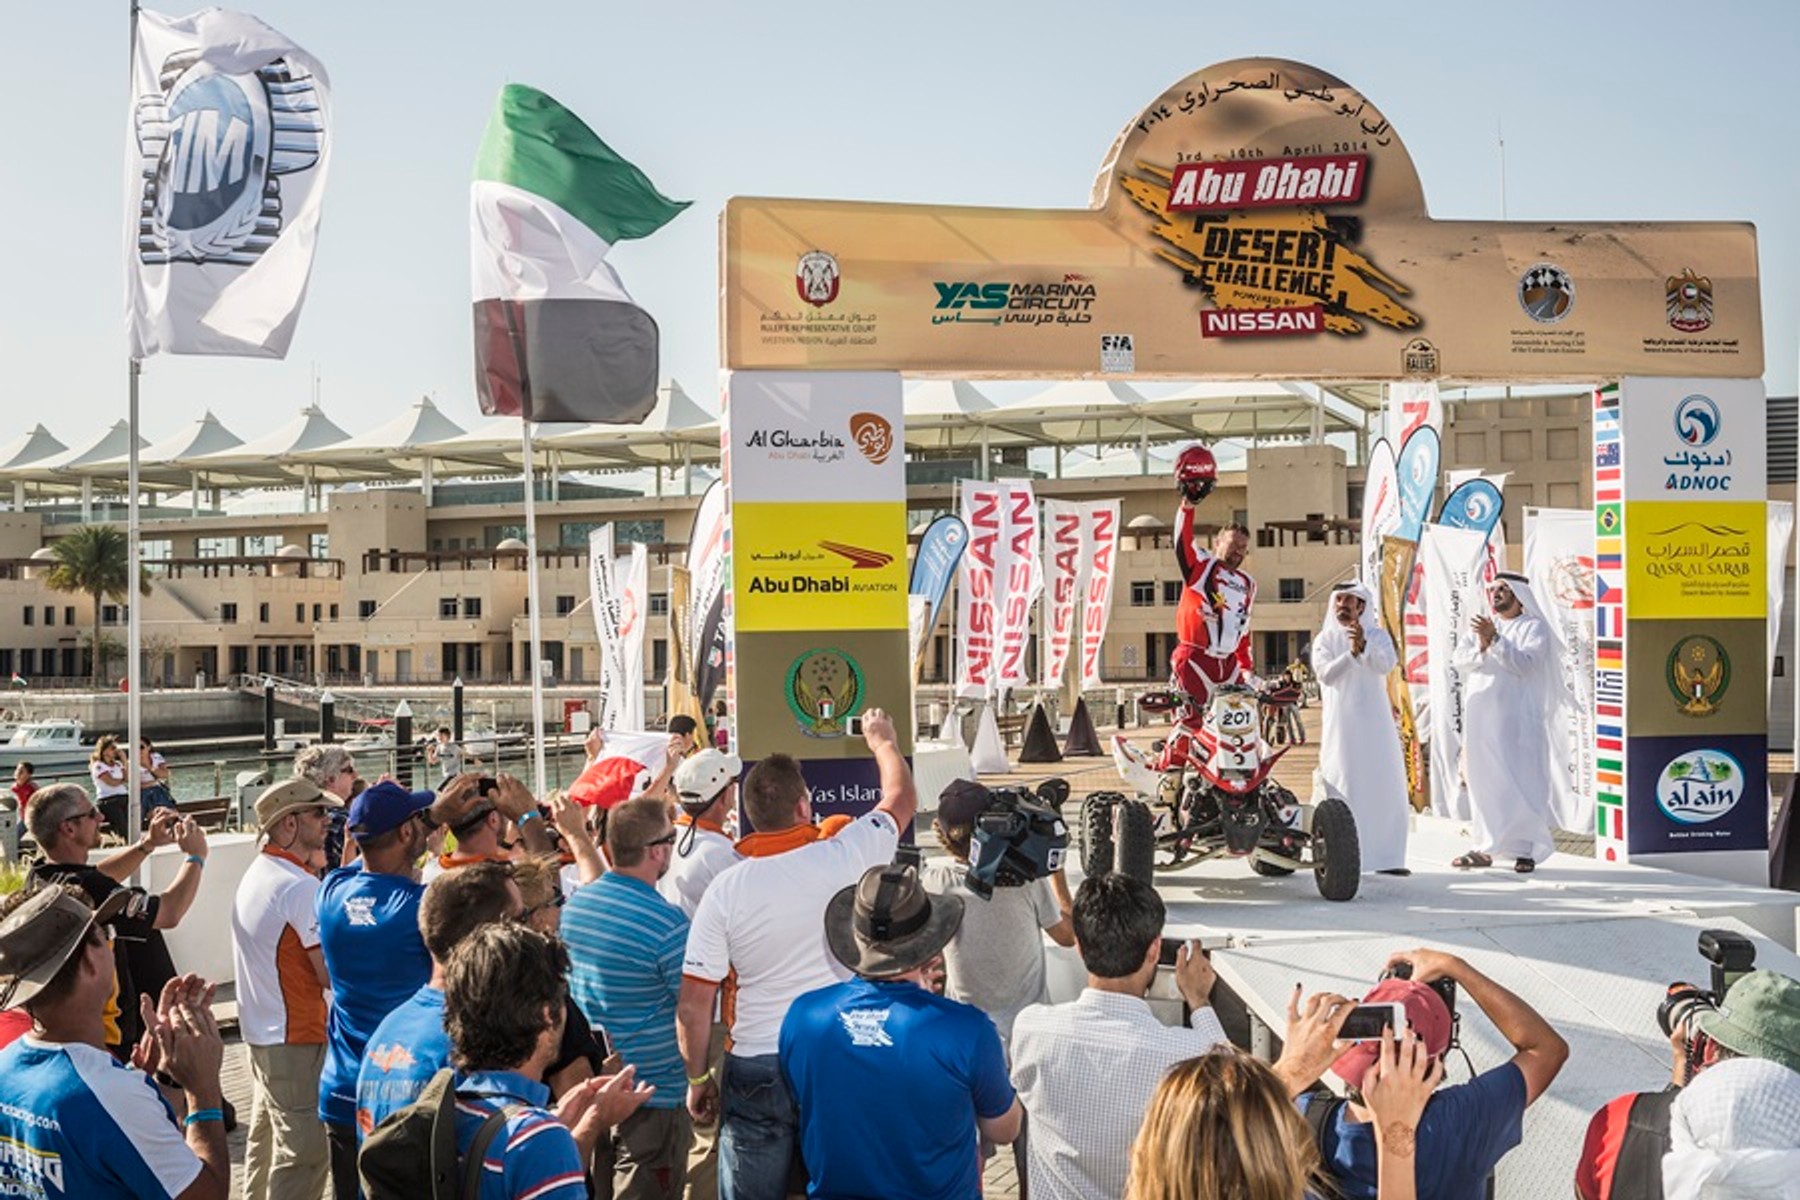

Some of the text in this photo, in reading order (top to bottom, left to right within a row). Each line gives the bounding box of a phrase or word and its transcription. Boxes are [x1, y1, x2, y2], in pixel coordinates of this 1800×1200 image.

[1178, 73, 1280, 115] الصحراوي
[1176, 152, 1203, 162] 3rd
[1229, 147, 1264, 159] 10th
[1283, 143, 1323, 156] April
[1333, 141, 1368, 153] 2014
[1170, 160, 1358, 206] Abu Dhabi
[1202, 227, 1338, 271] DESERT
[1010, 284, 1097, 297] MARINA
[1201, 260, 1336, 298] CHALLENGE
[933, 282, 1011, 309] YAS
[1007, 298, 1096, 311] CIRCUIT
[1207, 311, 1316, 331] NISSAN
[746, 430, 845, 447] Al Gharbia
[1665, 473, 1732, 490] ADNOC
[1646, 562, 1689, 579] QASR
[1707, 561, 1750, 578] SARAB
[749, 576, 898, 593] Abu Dhabi AVIATION
[967, 491, 1000, 686] NISSAN
[1001, 491, 1035, 681] NISSAN
[1051, 514, 1081, 678] NISSAN
[1084, 510, 1114, 677] NISSAN
[1222, 711, 1251, 726] 201
[840, 783, 884, 802] Islan
[1668, 782, 1734, 807] al ain
